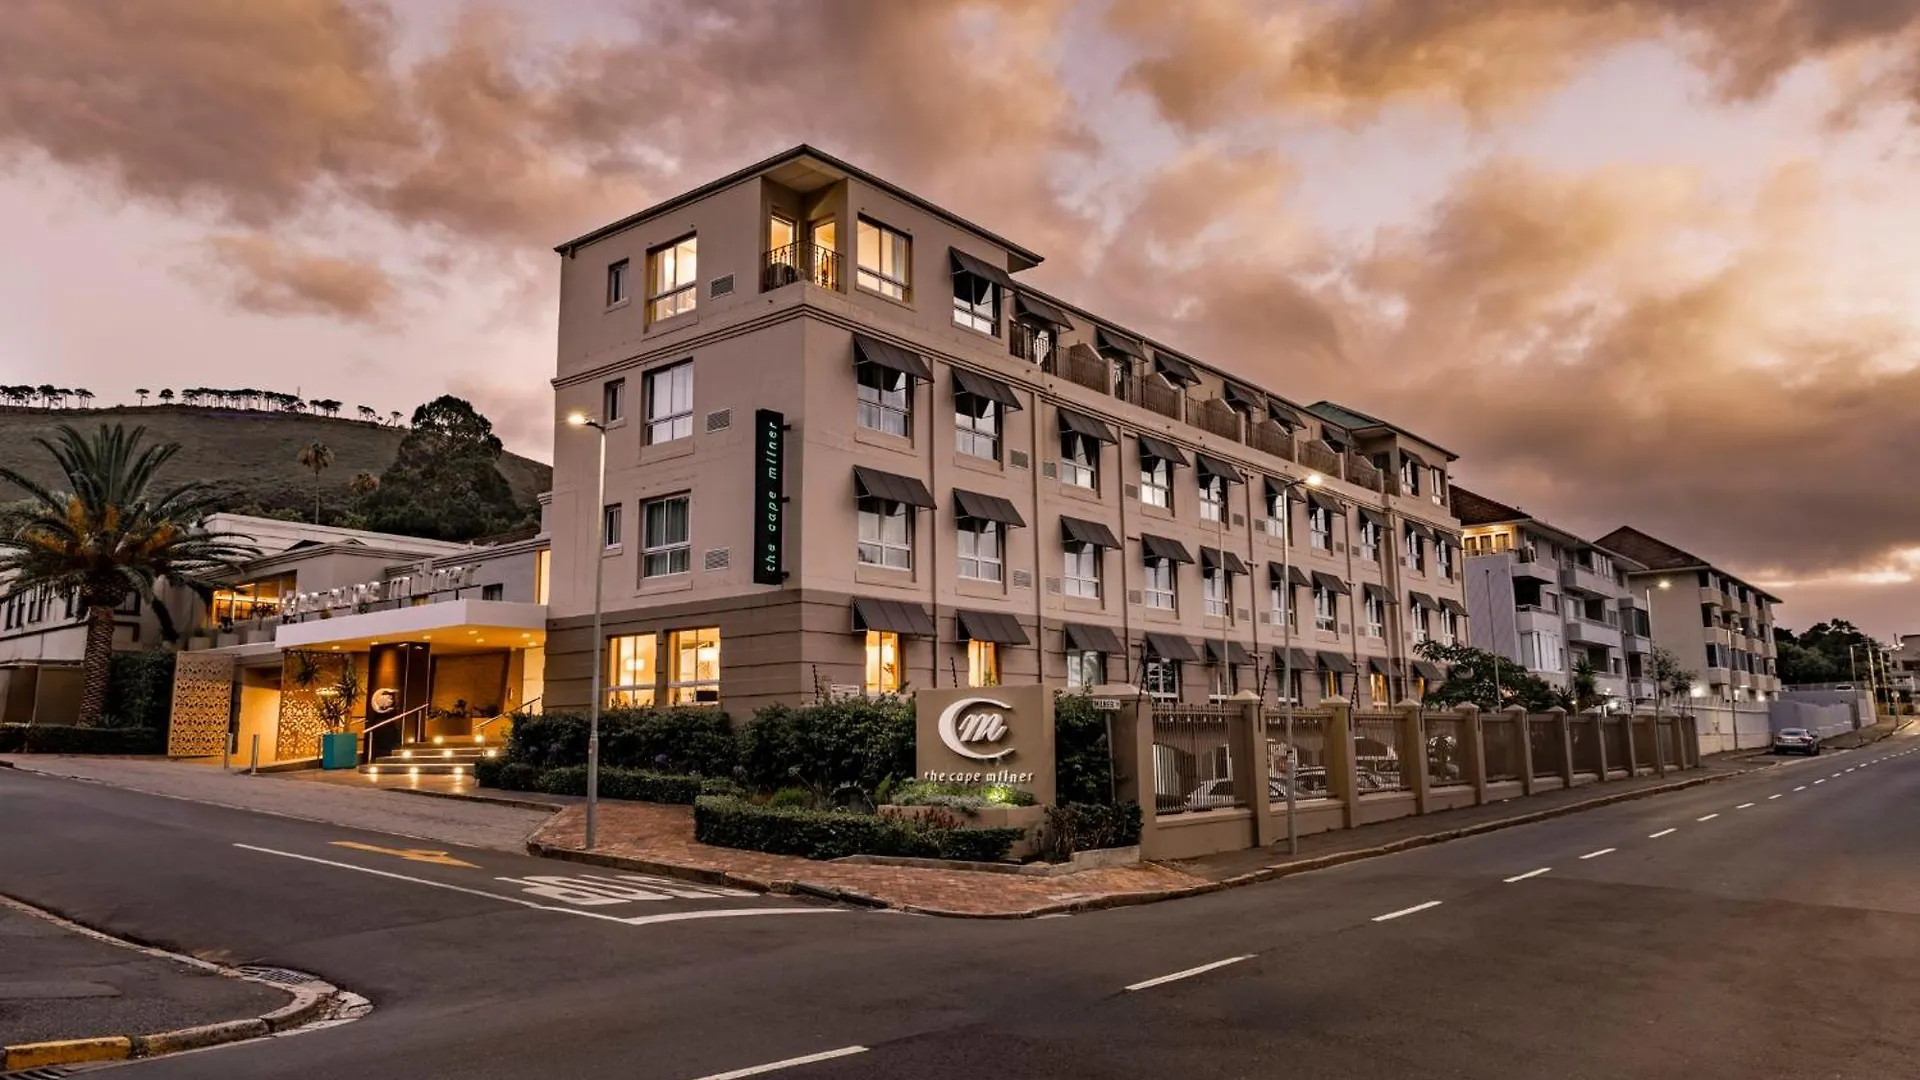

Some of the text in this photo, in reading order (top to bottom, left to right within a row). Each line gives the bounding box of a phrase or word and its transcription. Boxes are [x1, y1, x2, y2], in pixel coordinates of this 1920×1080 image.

[765, 421, 778, 572] the cape milner
[924, 769, 1034, 784] the cape milner
